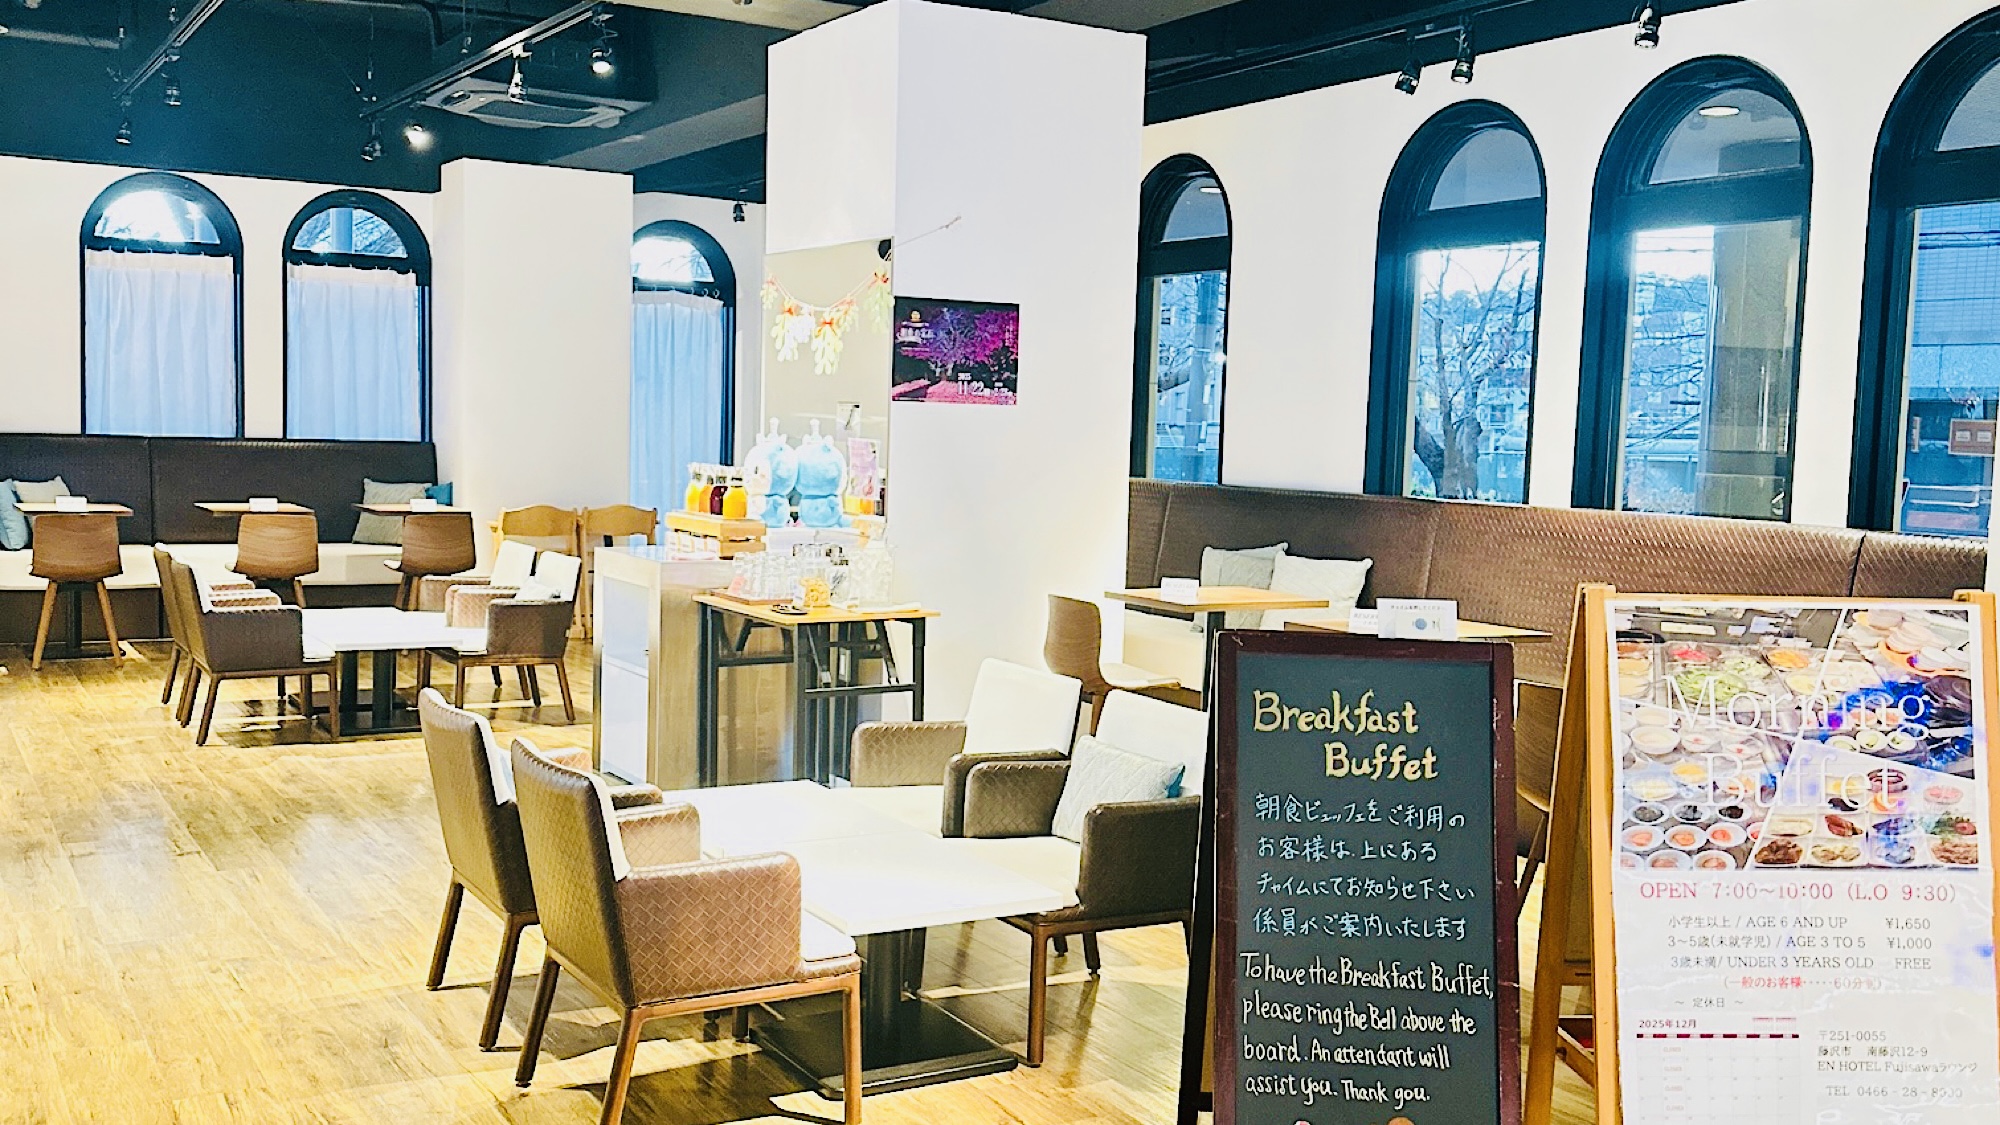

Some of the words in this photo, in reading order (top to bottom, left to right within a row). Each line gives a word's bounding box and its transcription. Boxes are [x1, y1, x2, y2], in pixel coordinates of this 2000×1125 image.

[1253, 688, 1419, 736] Breakfast
[1661, 674, 1932, 741] Morning
[1324, 741, 1439, 781] Buffet
[1704, 751, 1901, 808] Buffet
[1256, 871, 1477, 901] チャイムにてお知らせ下さい
[1640, 882, 1698, 899] OPEN
[1848, 883, 1889, 902] (L.O
[1901, 884, 1957, 903] 9:30)
[1253, 907, 1468, 941] 係員がご案内いたします
[1668, 915, 1731, 929] 小学生以上
[1746, 915, 1776, 929] AGE
[1780, 916, 1789, 929] 6
[1792, 916, 1825, 929] AND
[1828, 916, 1848, 929] UP
[1885, 917, 1932, 931] ¥1,650
[1786, 936, 1817, 949] AGE
[1820, 936, 1829, 949] 3
[1833, 936, 1853, 949] TO
[1857, 936, 1867, 949] 5
[1887, 936, 1933, 950] ¥1,000
[1240, 952, 1263, 978] To
[1264, 953, 1306, 986] have
[1308, 955, 1339, 985] the
[1339, 956, 1427, 990] Breakfast
[1430, 961, 1495, 1000] Buffet,
[1727, 956, 1777, 969] UNDER
[1781, 956, 1789, 969] 3
[1792, 956, 1842, 969] YEARS
[1844, 956, 1875, 970] OLD
[1894, 957, 1932, 970] FREE
[1242, 989, 1304, 1025] please
[1305, 1002, 1343, 1036] ring
[1343, 1000, 1369, 1031] the
[1366, 1002, 1397, 1031] Bell
[1400, 1005, 1446, 1033] above
[1448, 1007, 1477, 1035] the
[1692, 997, 1726, 1008] 定休日
[1638, 1018, 1697, 1029] 2025年12月
[1243, 1034, 1308, 1063] board.
[1311, 1037, 1331, 1063] An
[1333, 1043, 1416, 1067] attendant
[1418, 1044, 1451, 1070] will
[1817, 1045, 1852, 1057] 藤沢市
[1817, 1061, 1836, 1072] EN
[1838, 1061, 1882, 1072] HOTEL
[1245, 1074, 1299, 1097] assist
[1301, 1076, 1339, 1106] you.
[1340, 1079, 1390, 1104] Thank
[1825, 1085, 1850, 1097] TEL
